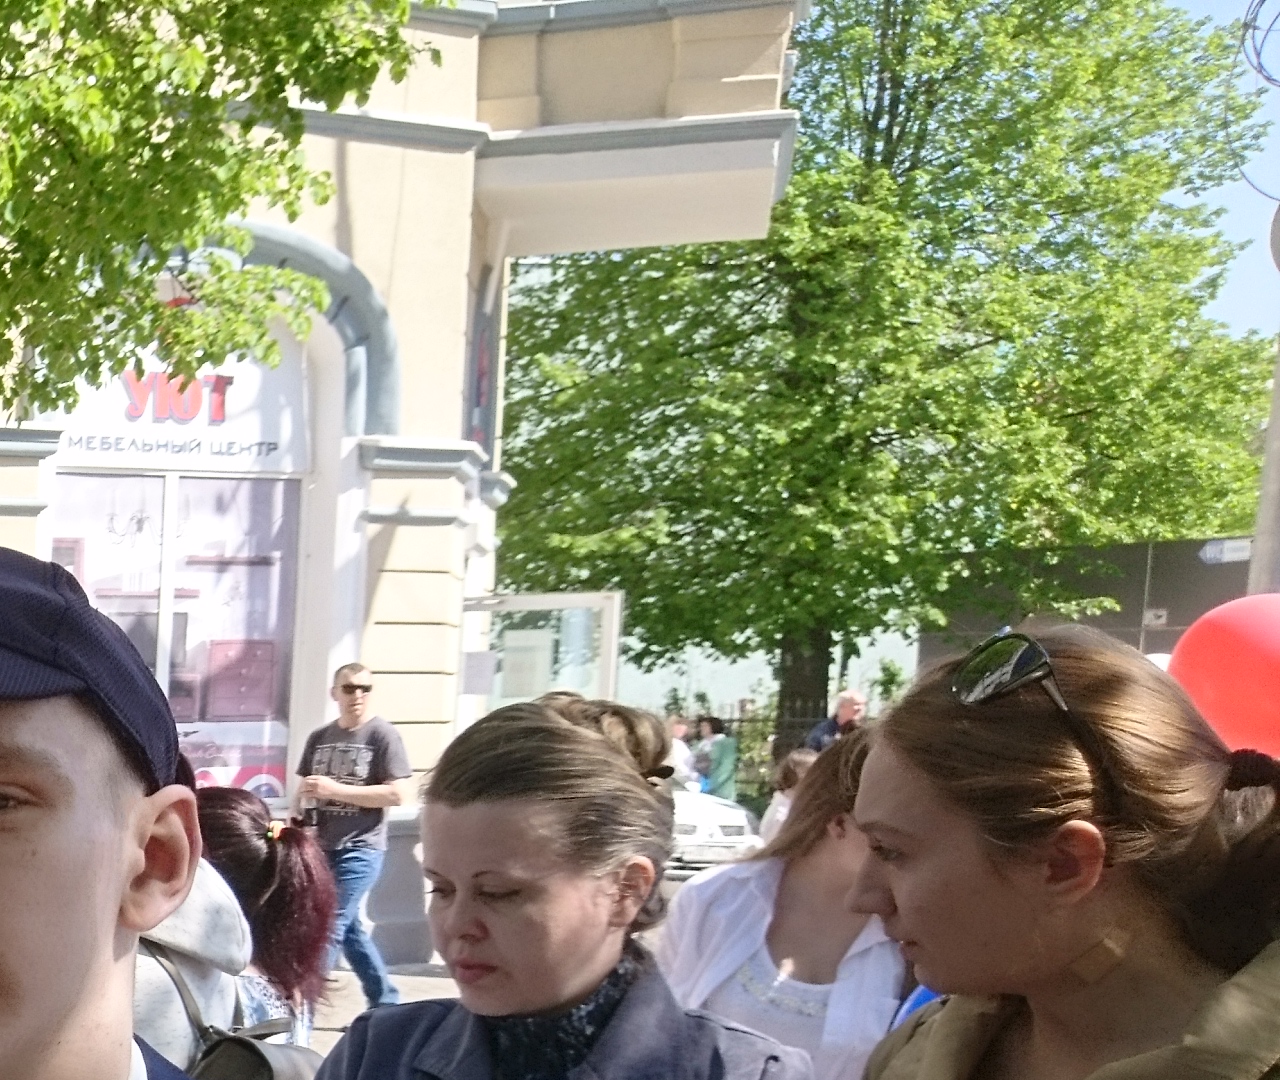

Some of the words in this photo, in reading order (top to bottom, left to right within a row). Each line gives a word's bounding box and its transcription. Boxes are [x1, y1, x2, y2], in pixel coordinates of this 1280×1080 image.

[121, 370, 234, 426] УЮТ
[68, 435, 202, 455] МЕБЕЛЬНЫЙ
[210, 441, 279, 457] ЦЕНТР
